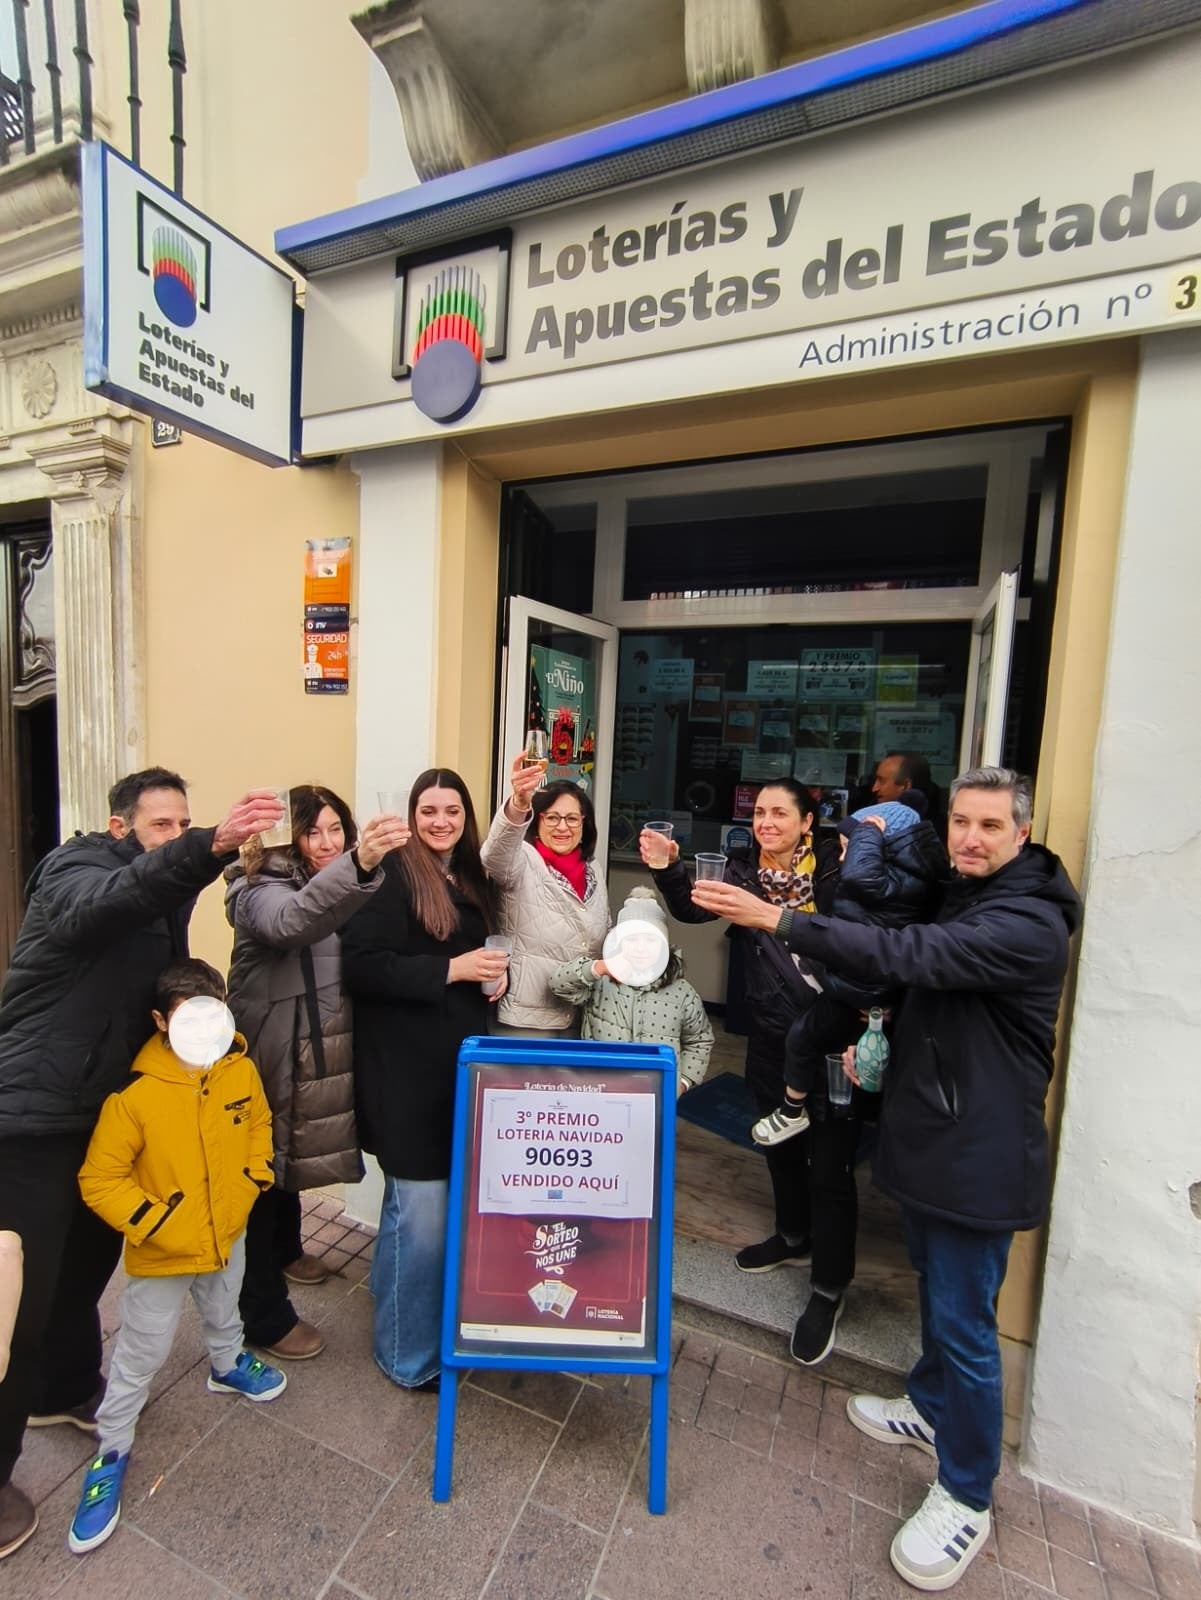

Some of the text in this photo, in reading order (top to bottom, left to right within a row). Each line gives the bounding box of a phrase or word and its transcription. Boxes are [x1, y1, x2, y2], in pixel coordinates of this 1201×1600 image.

[527, 186, 804, 289] Loterías y
[525, 169, 1201, 359] Apuestas del Estado
[798, 275, 1197, 368] Administración nº 3
[138, 311, 229, 378] Loterías y
[138, 361, 204, 408] Estado
[139, 338, 254, 410] Apuestas del
[306, 633, 348, 644] SEGURIDAD
[553, 668, 584, 695] Niño
[537, 1111, 599, 1126] PREMIO
[497, 1128, 623, 1144] LOTERIA NAVIDAD
[525, 1147, 593, 1168] 90693
[501, 1174, 619, 1191] VENDIDO AQUÍ
[533, 1224, 578, 1250] SORTEO
[536, 1247, 577, 1269] NOS UNE
